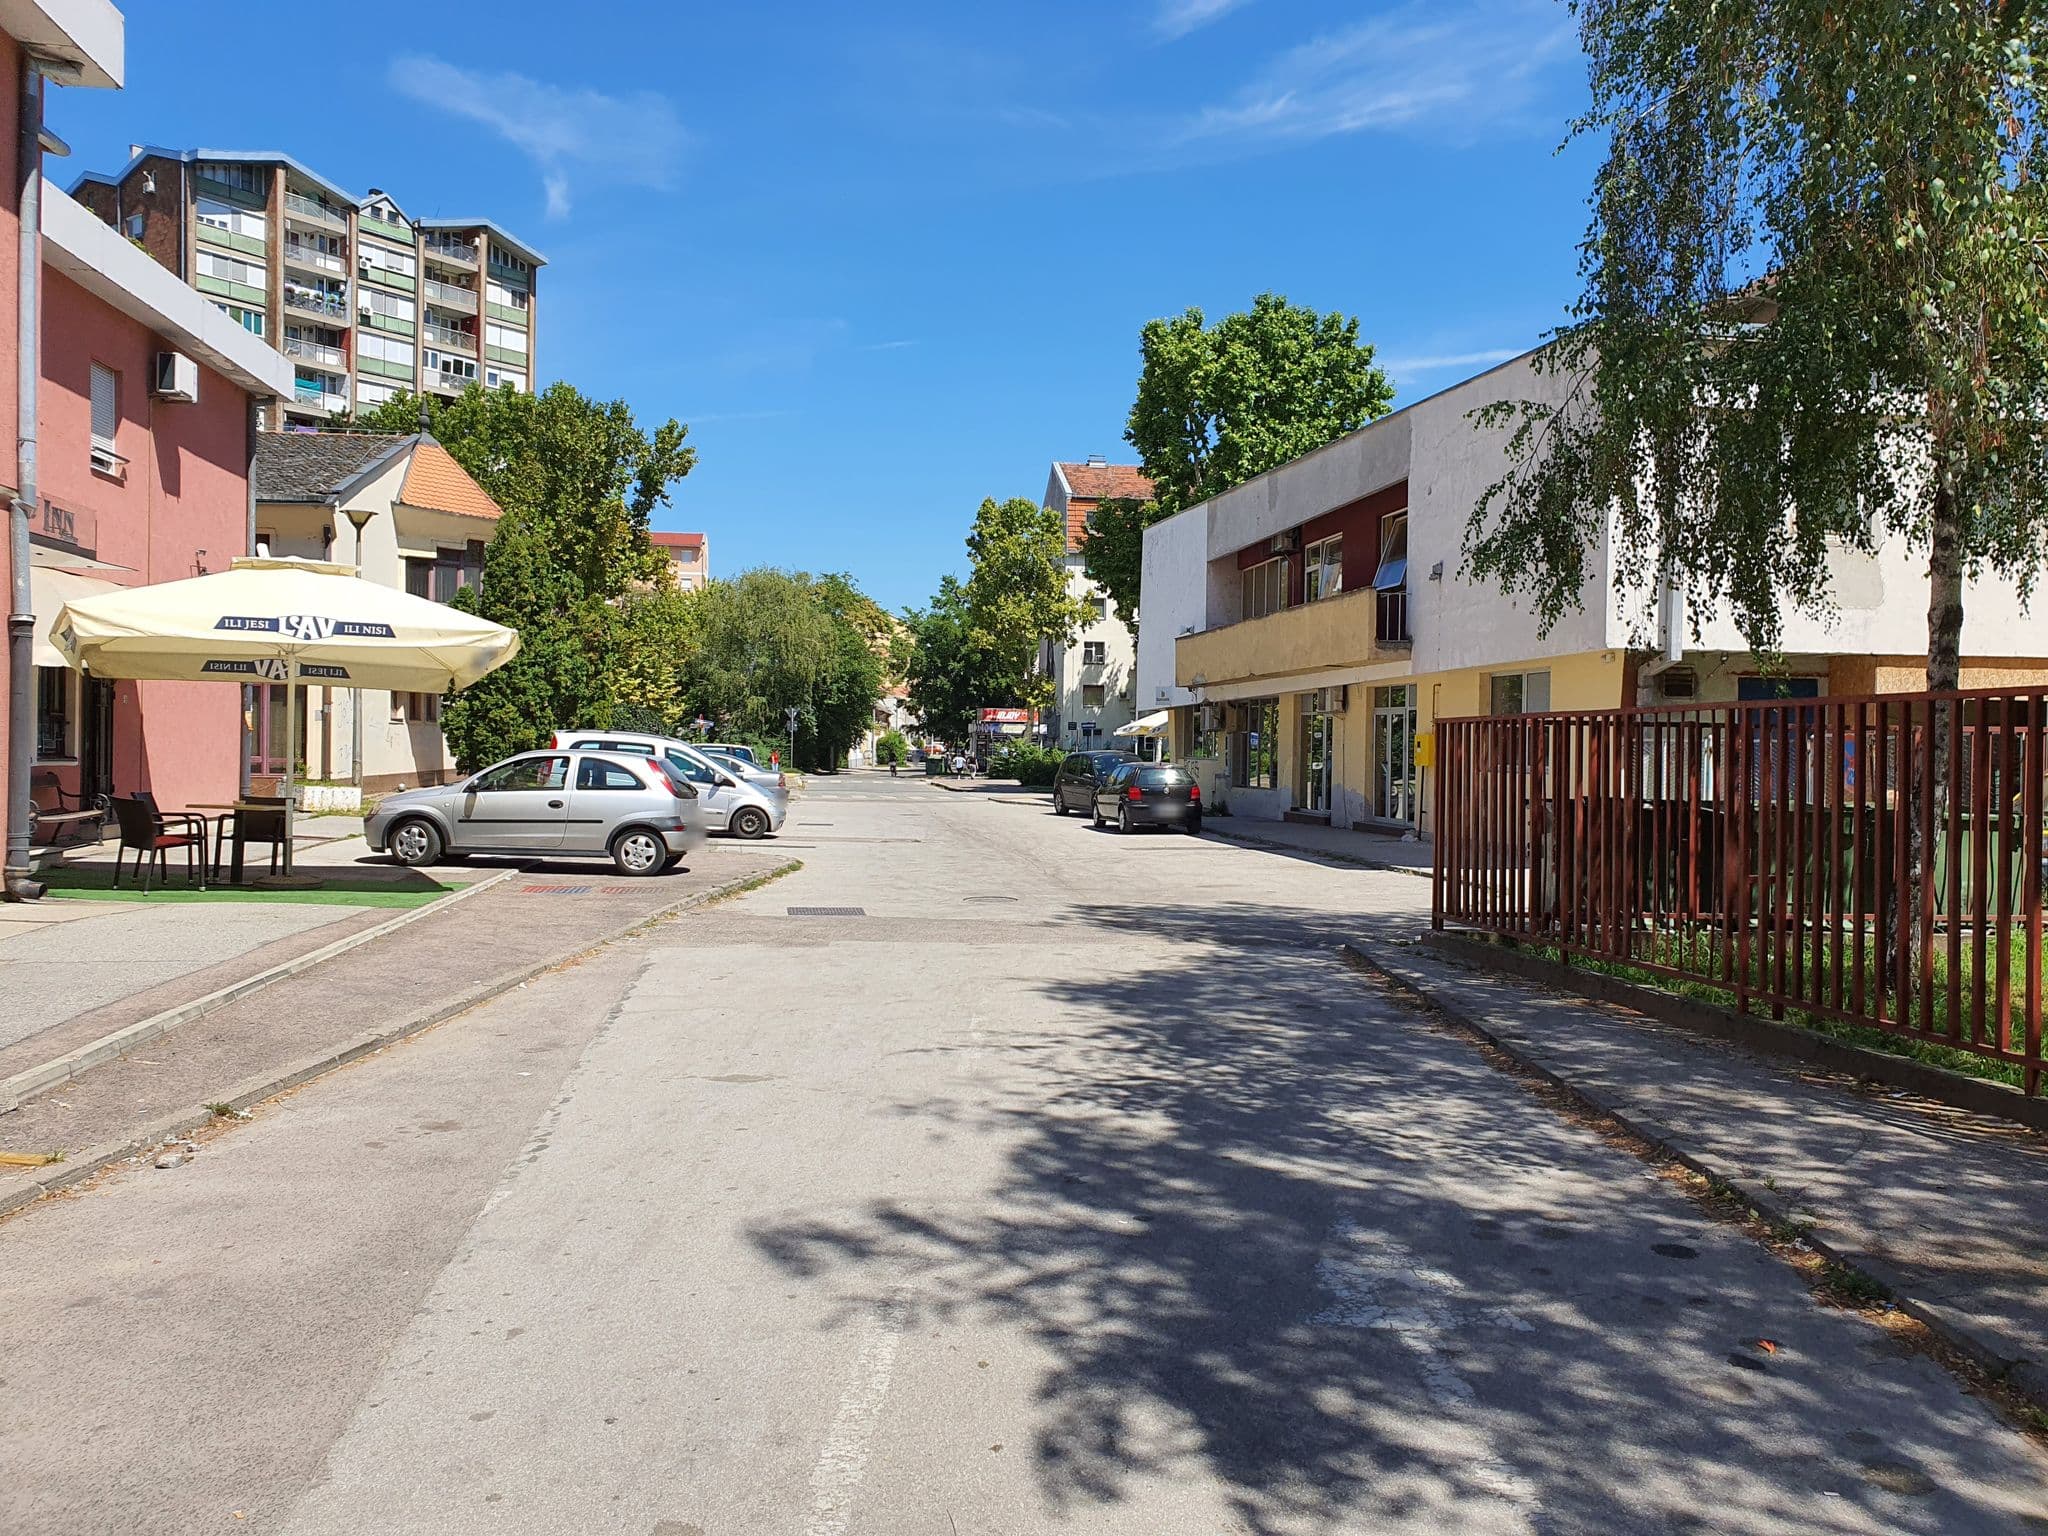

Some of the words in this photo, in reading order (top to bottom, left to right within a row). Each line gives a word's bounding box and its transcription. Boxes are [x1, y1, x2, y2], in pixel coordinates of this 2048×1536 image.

[224, 618, 242, 628] ILI
[244, 619, 269, 630] JESI
[278, 614, 337, 640] LAV
[344, 624, 360, 634] ILI
[362, 625, 387, 636] NISI
